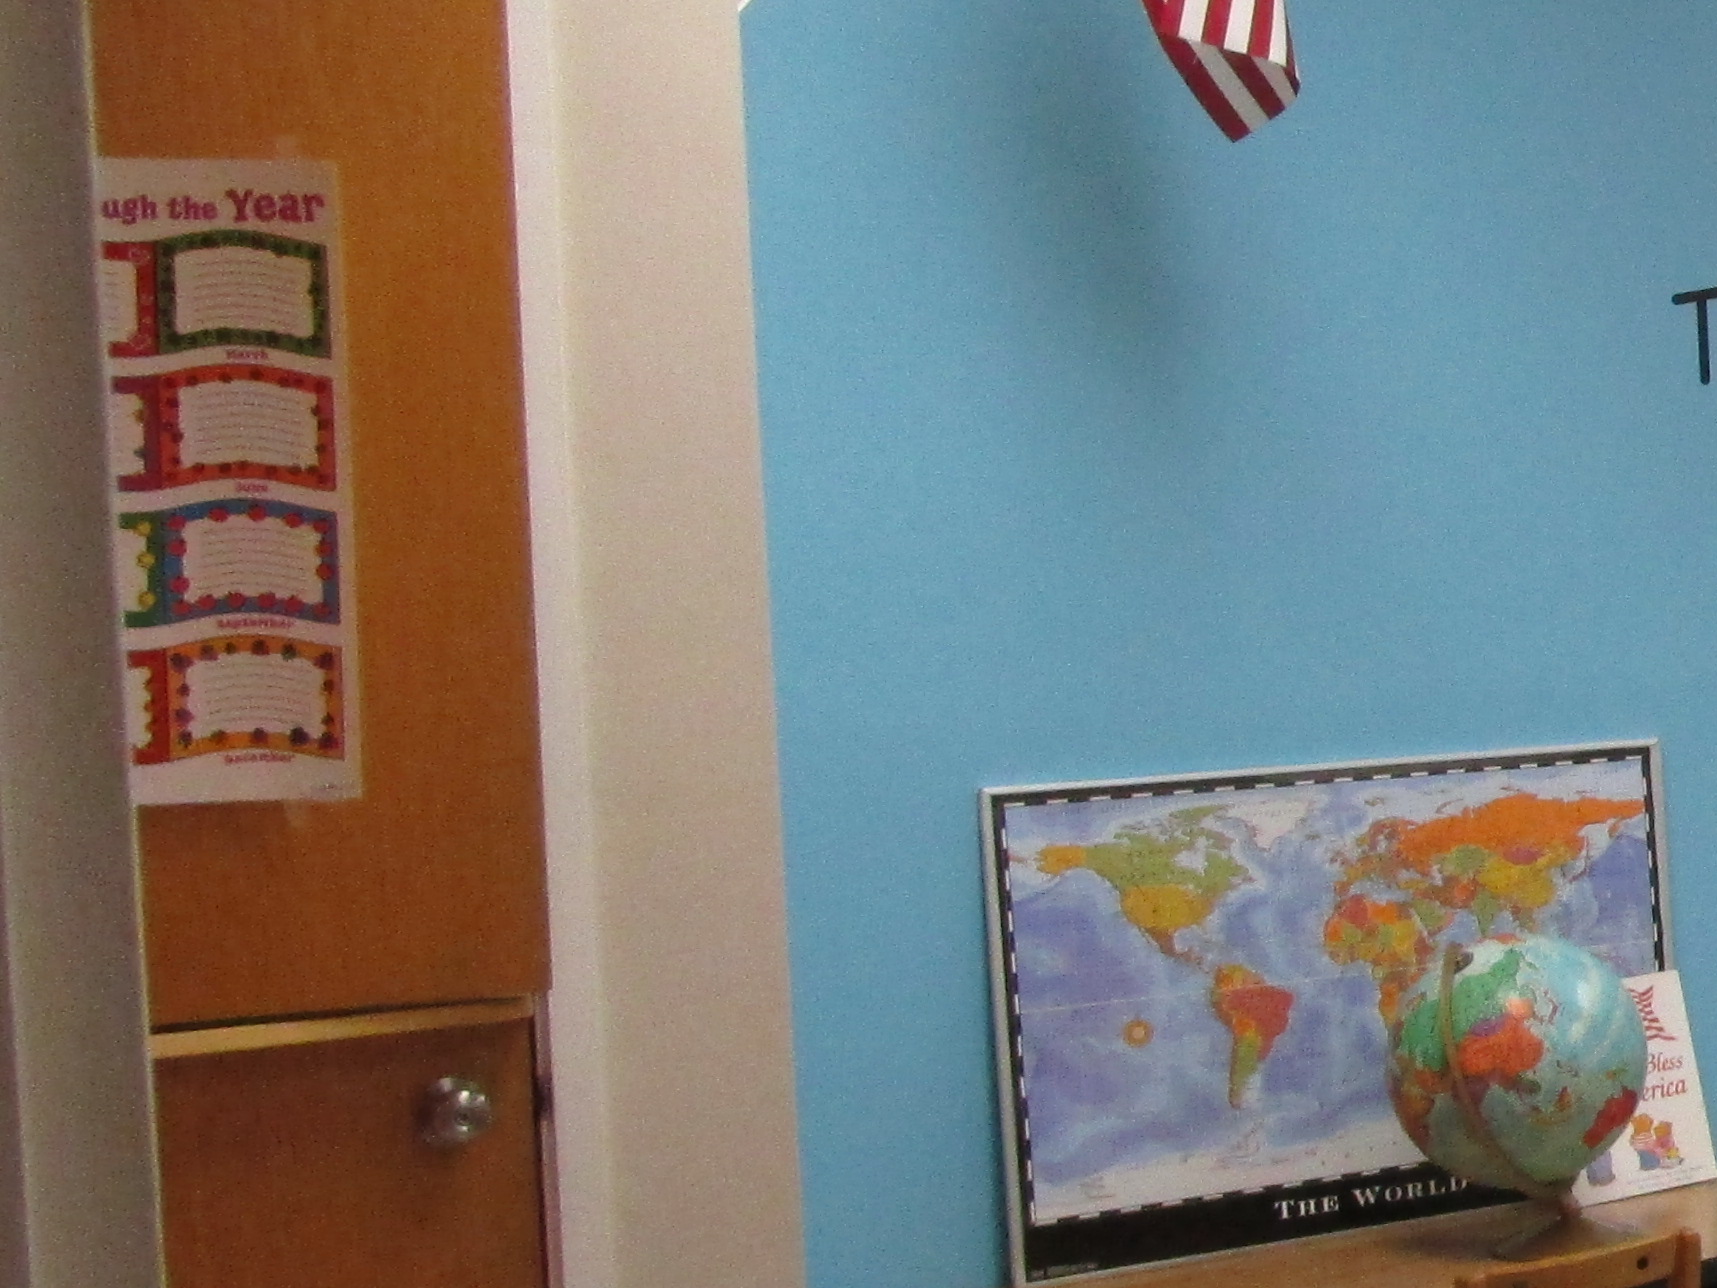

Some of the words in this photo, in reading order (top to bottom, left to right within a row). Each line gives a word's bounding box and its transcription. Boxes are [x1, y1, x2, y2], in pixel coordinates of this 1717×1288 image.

[102, 194, 158, 225] ugh
[167, 195, 218, 220] the
[225, 188, 325, 222] Year
[1640, 1078, 1689, 1103] erica
[1273, 1194, 1340, 1220] THE
[1351, 1175, 1469, 1208] WORLD
